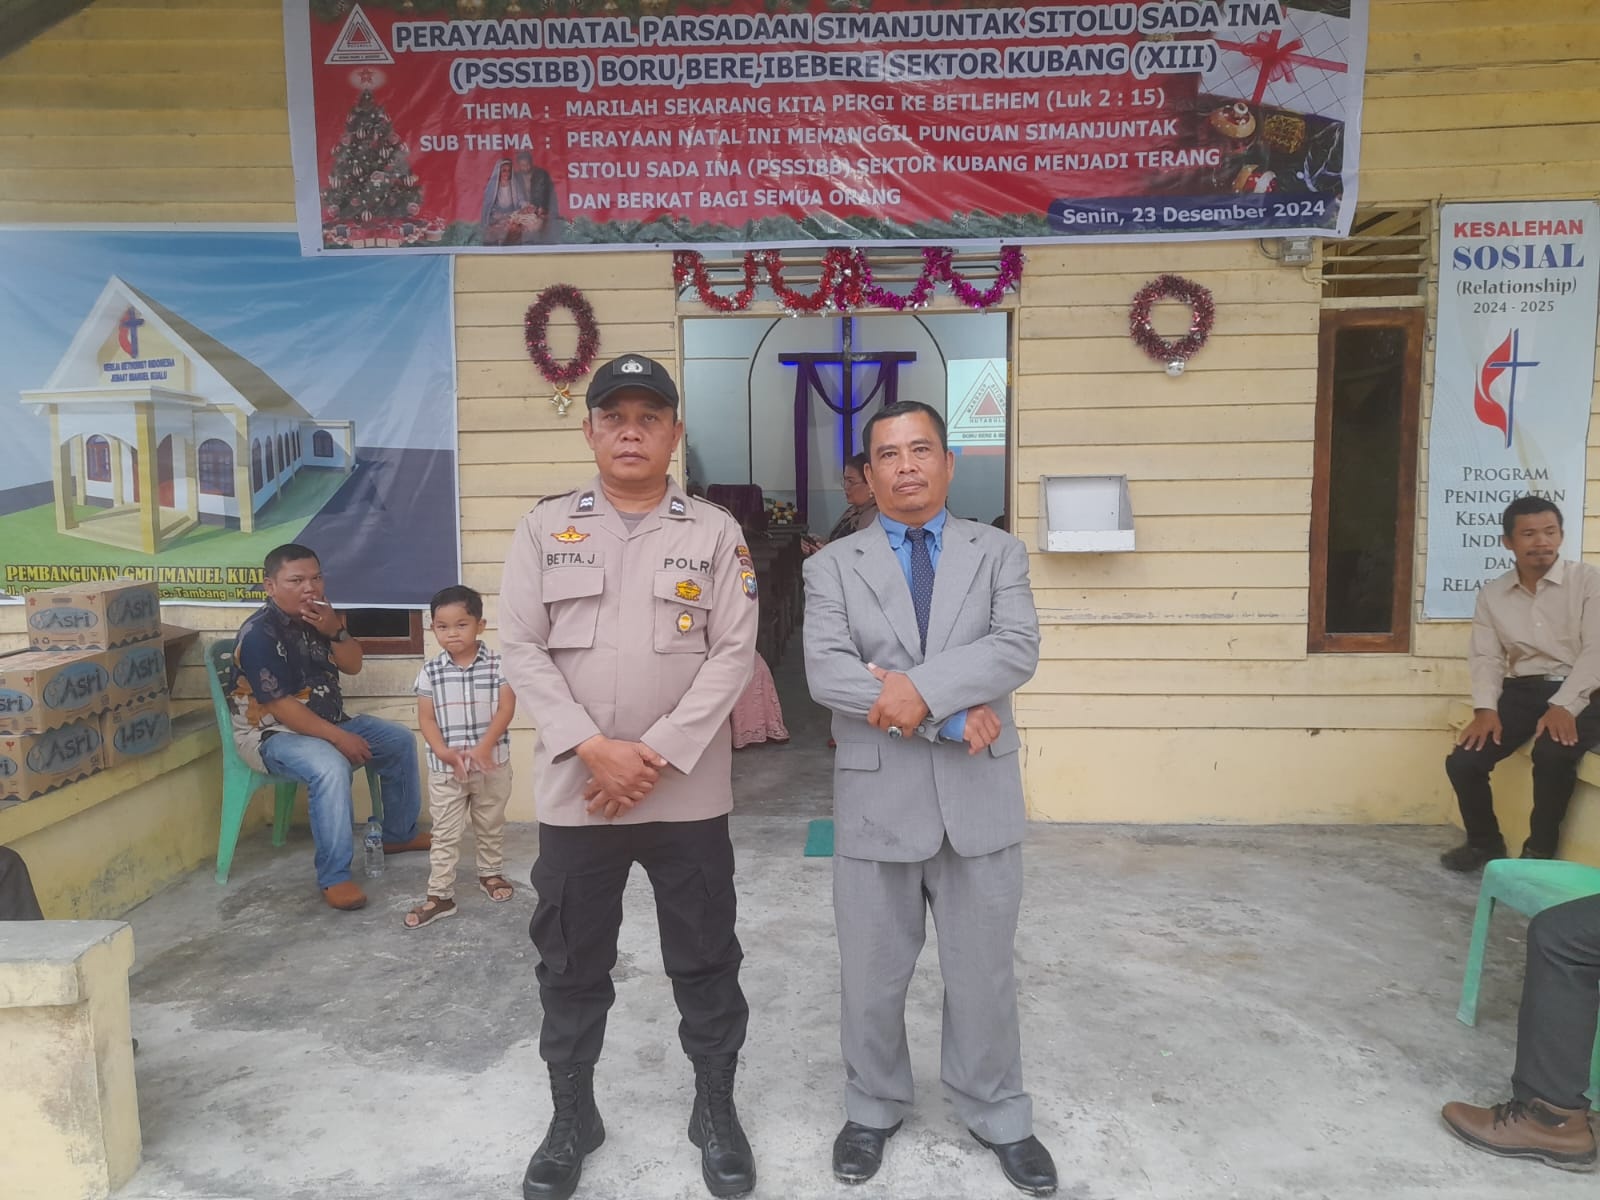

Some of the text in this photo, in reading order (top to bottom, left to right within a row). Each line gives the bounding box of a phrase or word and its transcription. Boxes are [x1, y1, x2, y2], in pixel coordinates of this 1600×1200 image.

[396, 3, 1282, 48] PERAYAAN NATAL PARSADAAN SIMANJUNTAK SITOLU SADA INA
[452, 59, 592, 90] (PSSSIBB)
[888, 51, 998, 79] SEKTOR
[1008, 48, 1126, 75] KUBANG
[1134, 44, 1218, 76] (XIII)
[463, 103, 532, 120] THEMA
[566, 98, 658, 116] MARILAH
[664, 97, 771, 116] SEKARANG
[778, 96, 826, 114] KITA
[832, 94, 894, 112] PERGI
[901, 94, 926, 111] KE
[932, 92, 1040, 112] BETLEHEM
[1046, 89, 1093, 112] (Luk
[1099, 89, 1110, 107] 2
[1130, 87, 1165, 109] 15)
[420, 135, 459, 152] SUB
[465, 134, 533, 151] THEMA
[567, 130, 672, 149] PERAYAAN
[678, 128, 742, 146] NATAL
[748, 127, 781, 145] INI
[787, 125, 913, 145] MEMANGGIL
[919, 125, 1019, 143] PUNGUAN
[1025, 119, 1177, 141] SIMANJUNTAK
[567, 148, 1220, 179] SITOLU SADA INA (PSSSIBB) SEKTOR KUBANG MENJADI TERANG
[568, 188, 901, 210] DAN BERKAT BAGI SEMUA ORANG
[1062, 200, 1326, 226] Senin, 23 Desember 2024
[1453, 219, 1584, 239] KESALEHAN
[1452, 243, 1585, 272] SOSIAL
[1456, 276, 1577, 297] (Relationship)
[1473, 301, 1507, 314] 2024
[1520, 300, 1555, 313] 2025
[1463, 466, 1549, 482] PROGRAM
[546, 552, 595, 566] BETTA. J
[6, 565, 119, 583] PEMBANGUNAN
[158, 567, 223, 584] IMANUEL
[175, 587, 226, 600] Tambang
[235, 588, 268, 600] Kamp
[46, 612, 91, 628] Asri
[60, 669, 103, 704] Asri
[0, 695, 25, 711] sri
[45, 728, 93, 768] Asri
